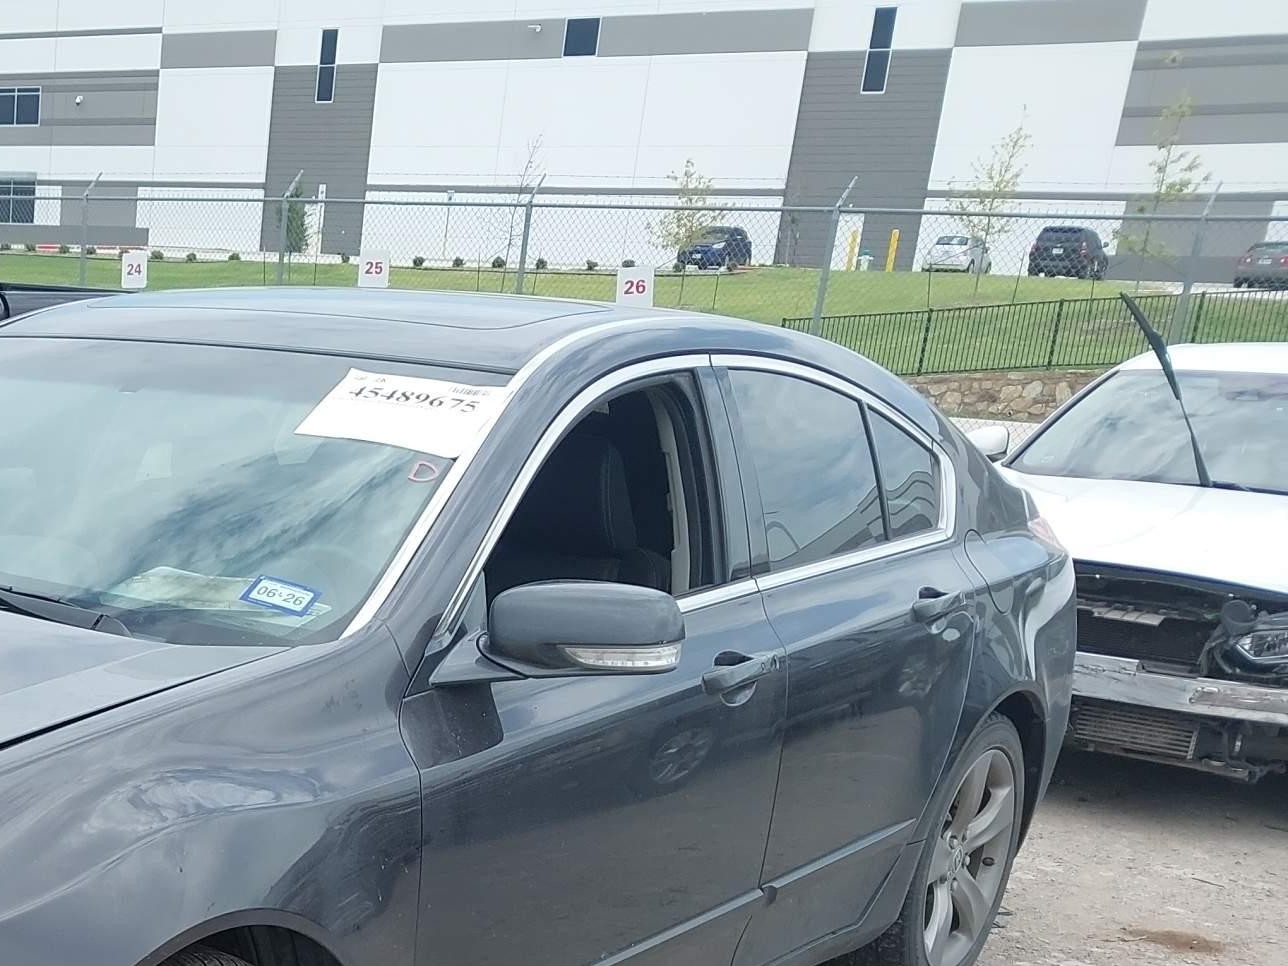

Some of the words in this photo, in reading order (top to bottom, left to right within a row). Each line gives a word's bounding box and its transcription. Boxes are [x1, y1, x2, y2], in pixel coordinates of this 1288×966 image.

[126, 263, 142, 276] 24
[364, 261, 383, 275] 25
[623, 279, 646, 295] 26
[349, 385, 481, 413] 45489675
